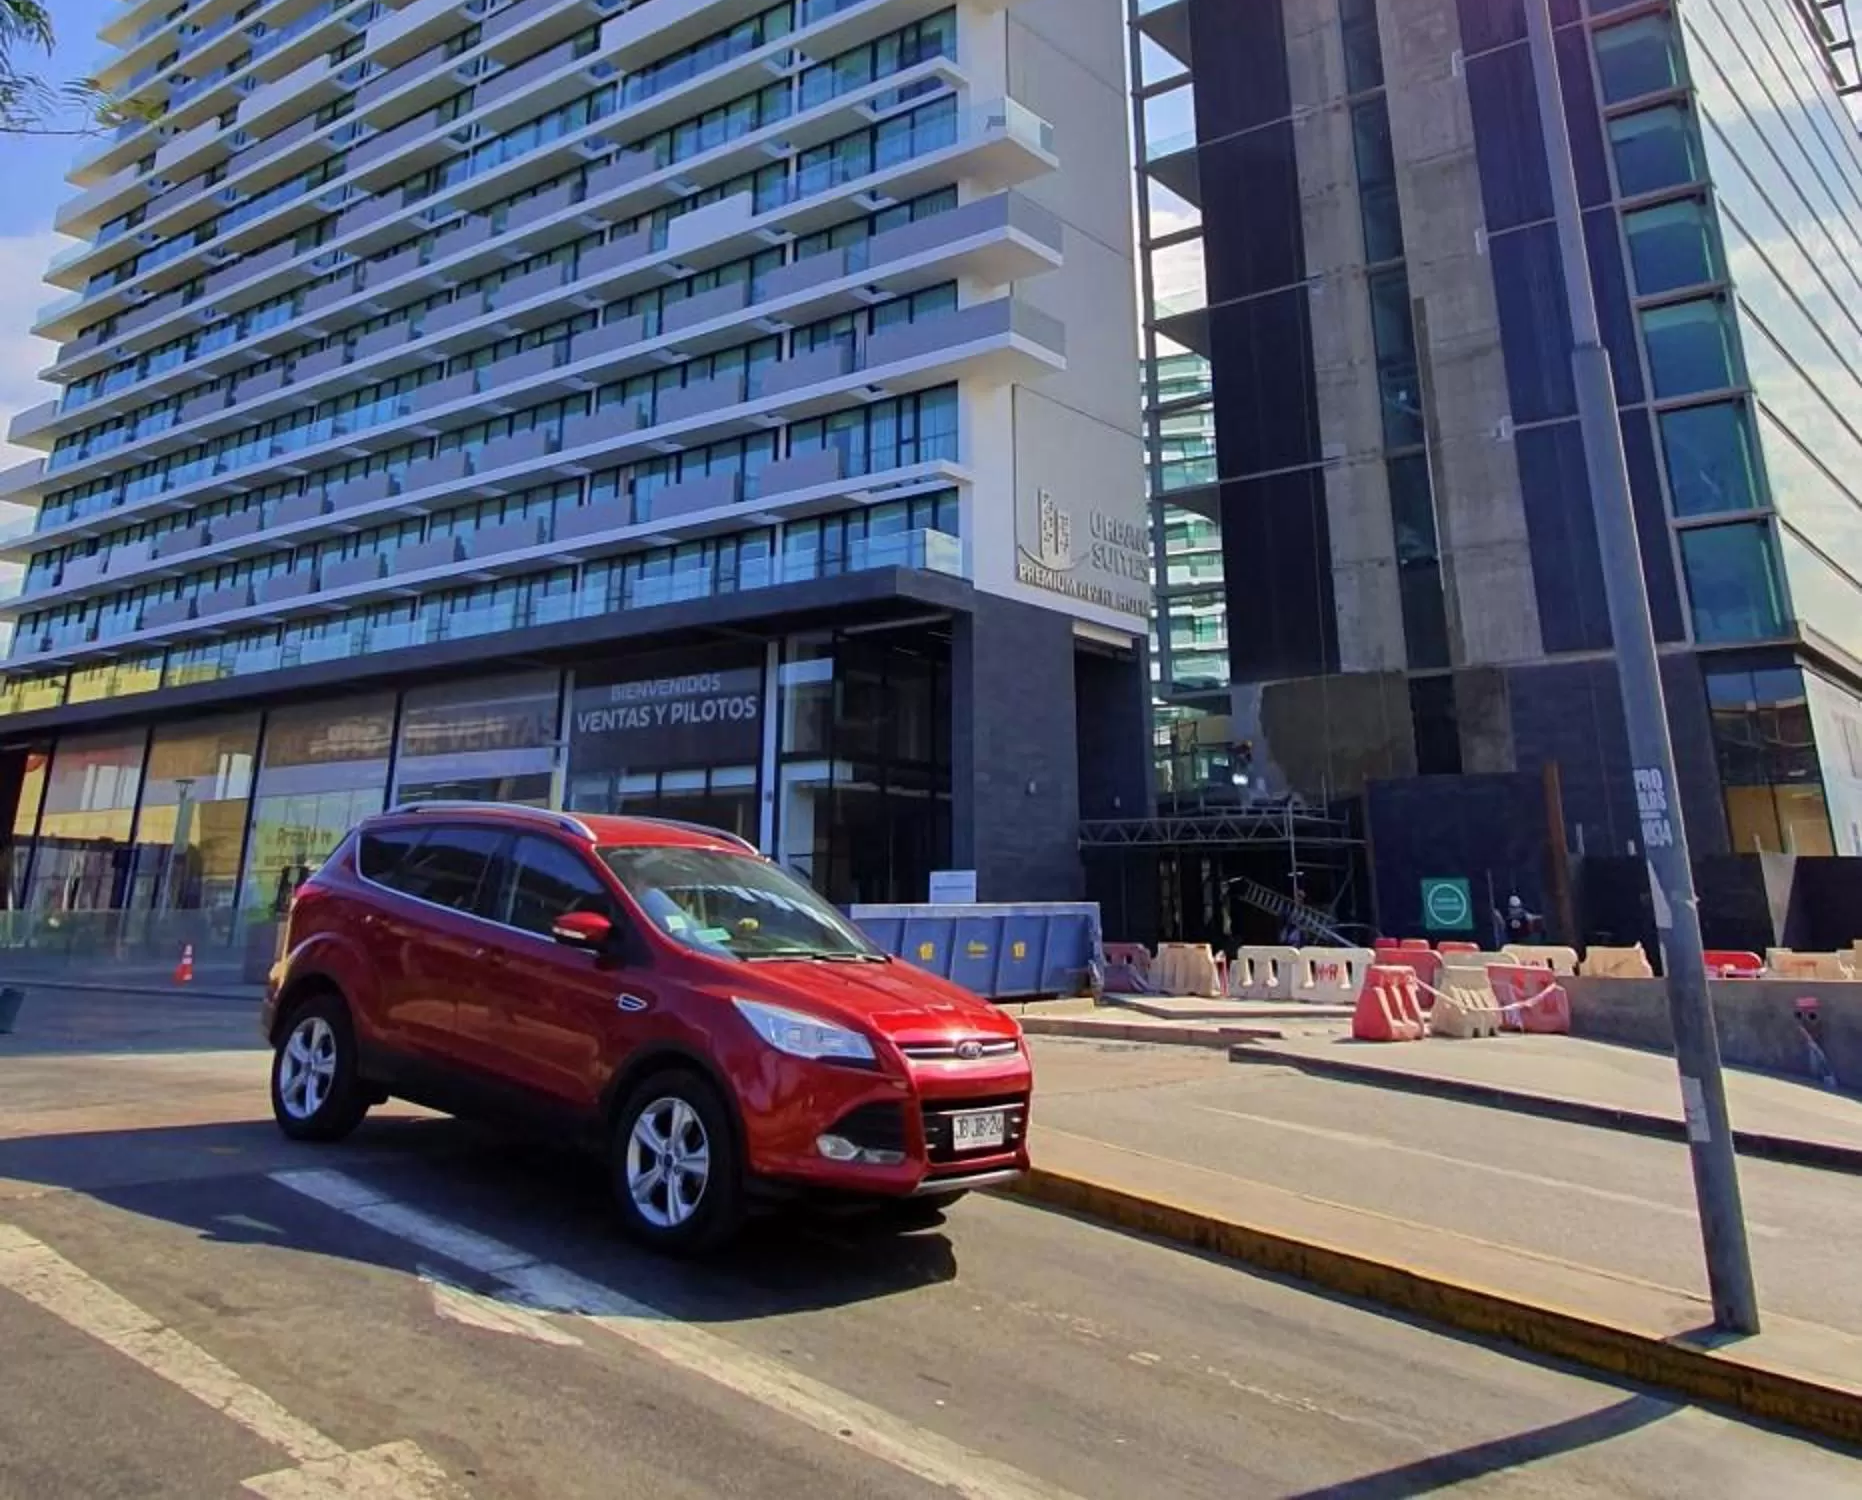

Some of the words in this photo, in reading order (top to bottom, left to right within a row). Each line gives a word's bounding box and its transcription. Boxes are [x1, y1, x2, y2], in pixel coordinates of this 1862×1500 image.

[1018, 563, 1079, 598] PREMIUM
[611, 673, 721, 701] BIENVENIDOS
[577, 705, 650, 733] VENTAS
[653, 703, 667, 725] Y
[670, 695, 757, 725] PILOTOS
